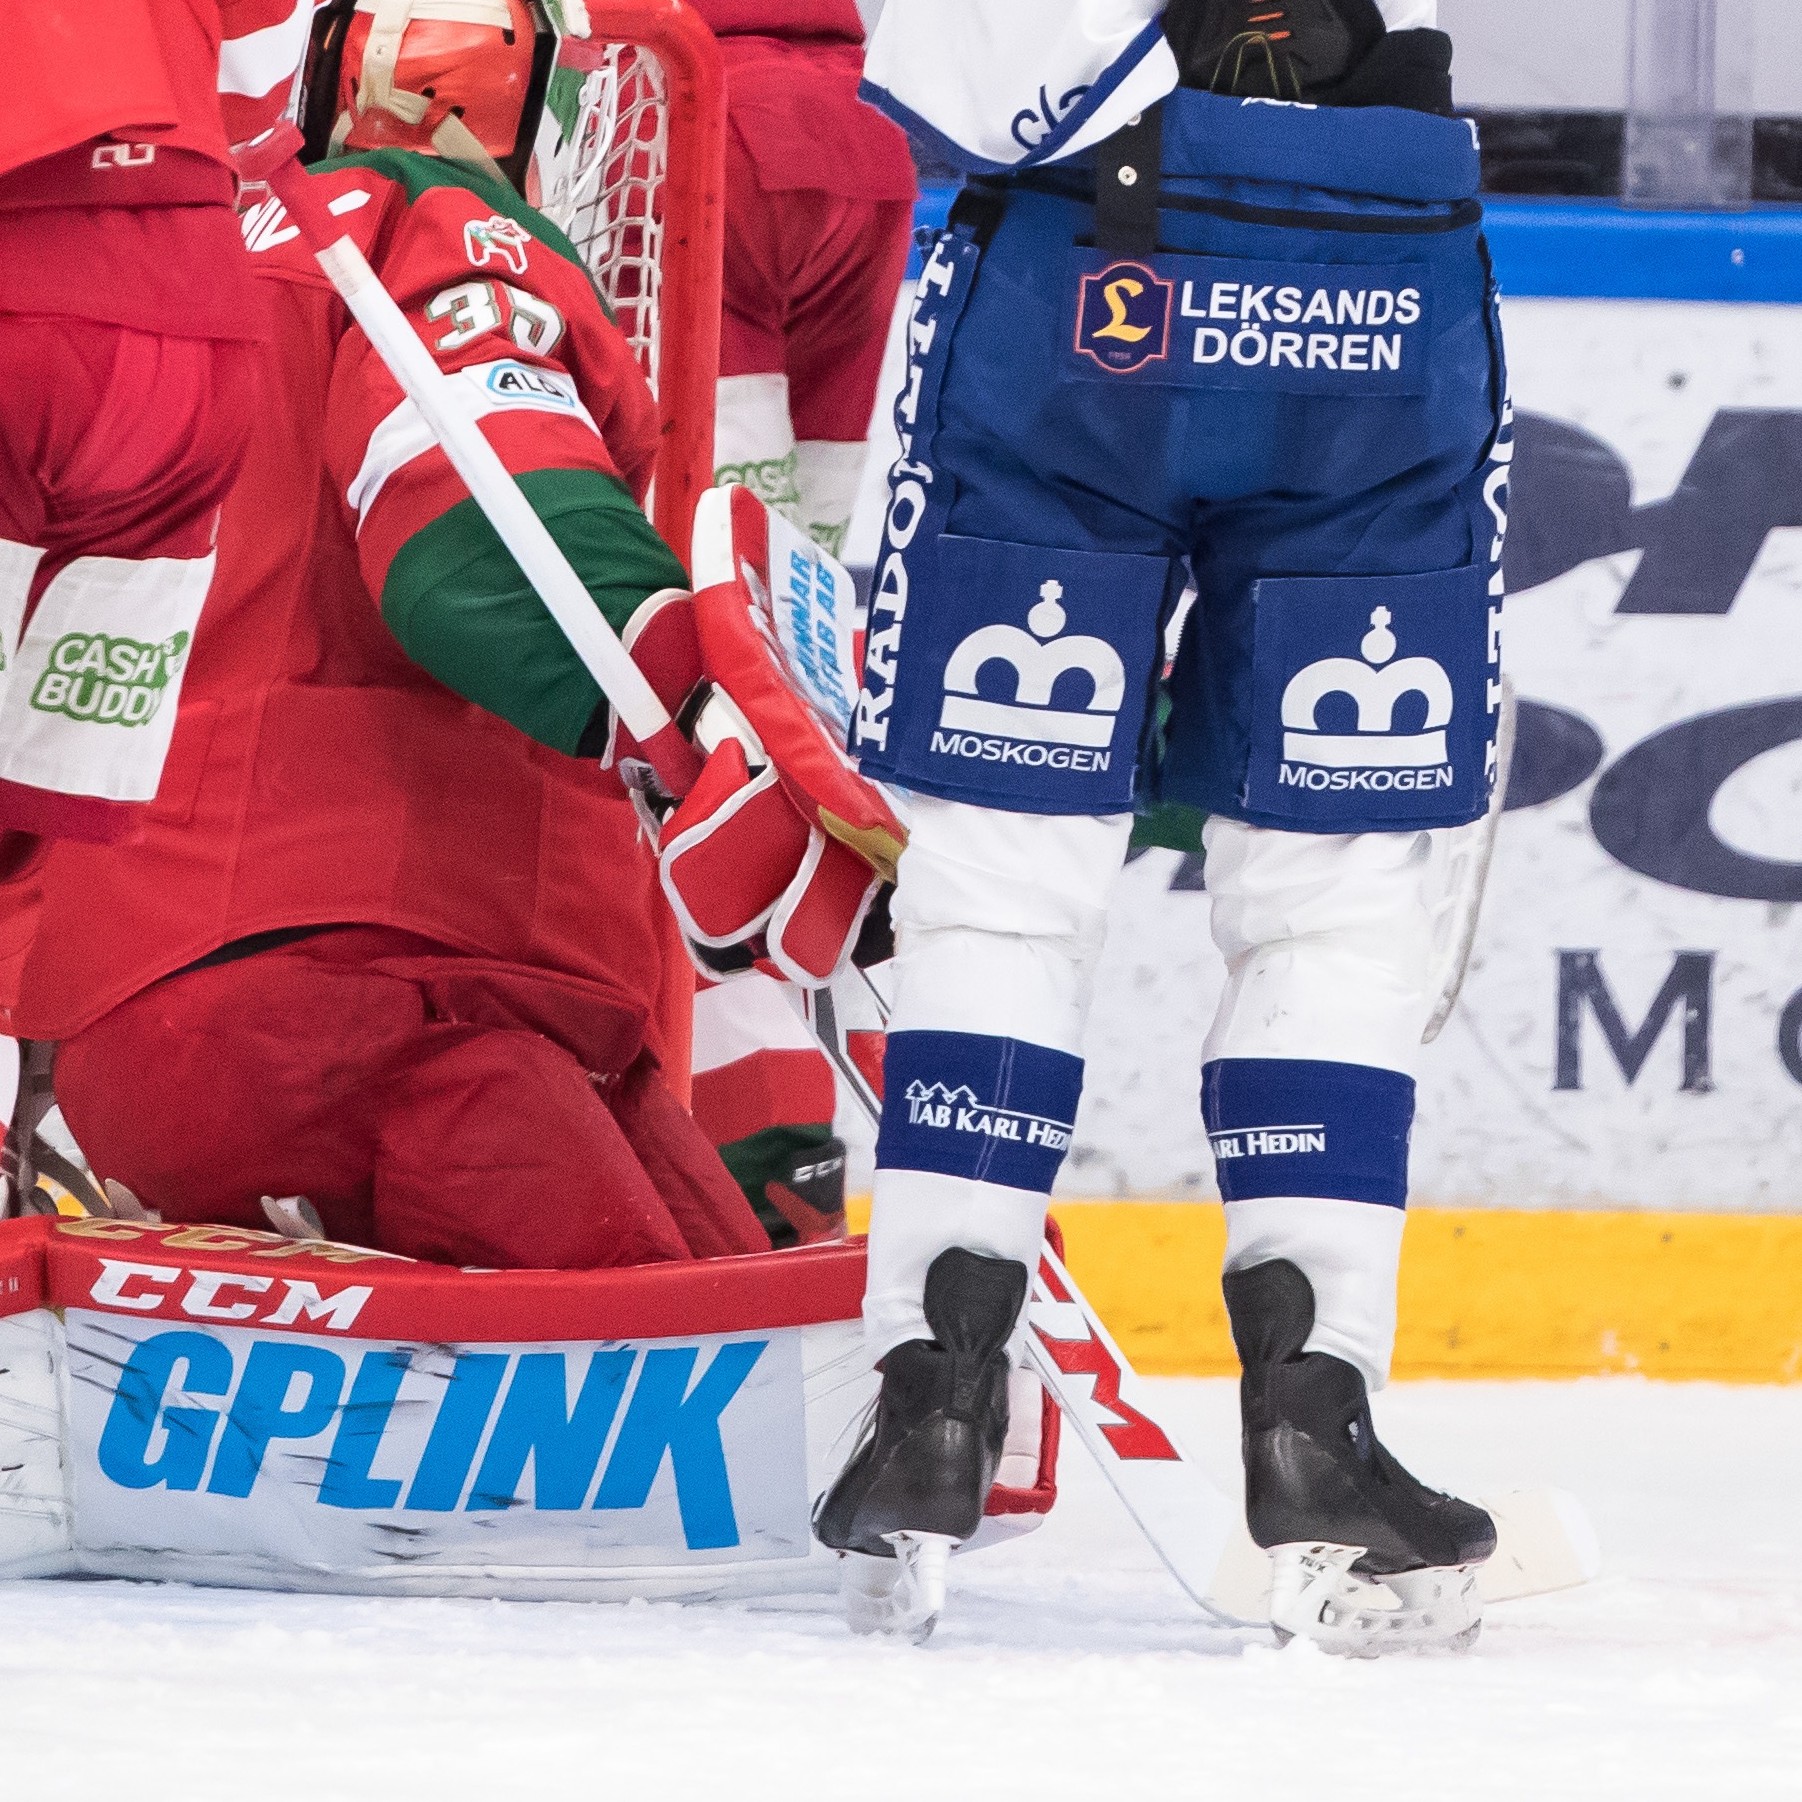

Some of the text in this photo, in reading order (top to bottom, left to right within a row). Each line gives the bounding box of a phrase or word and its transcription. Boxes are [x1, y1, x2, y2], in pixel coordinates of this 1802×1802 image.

[1180, 280, 1421, 326] LEKSANDS
[1192, 321, 1402, 371] DÖRREN
[52, 636, 161, 684] CASH
[37, 673, 166, 723] BUDDY
[929, 731, 1111, 773] MOSKOGEN
[1278, 761, 1454, 793] MOSKOGEN
[908, 1095, 1072, 1152] TAB KARL HEDI
[1210, 1131, 1325, 1160] ARL HEDIN
[89, 1258, 373, 1331] CCM
[96, 1327, 769, 1551] GPLINK
